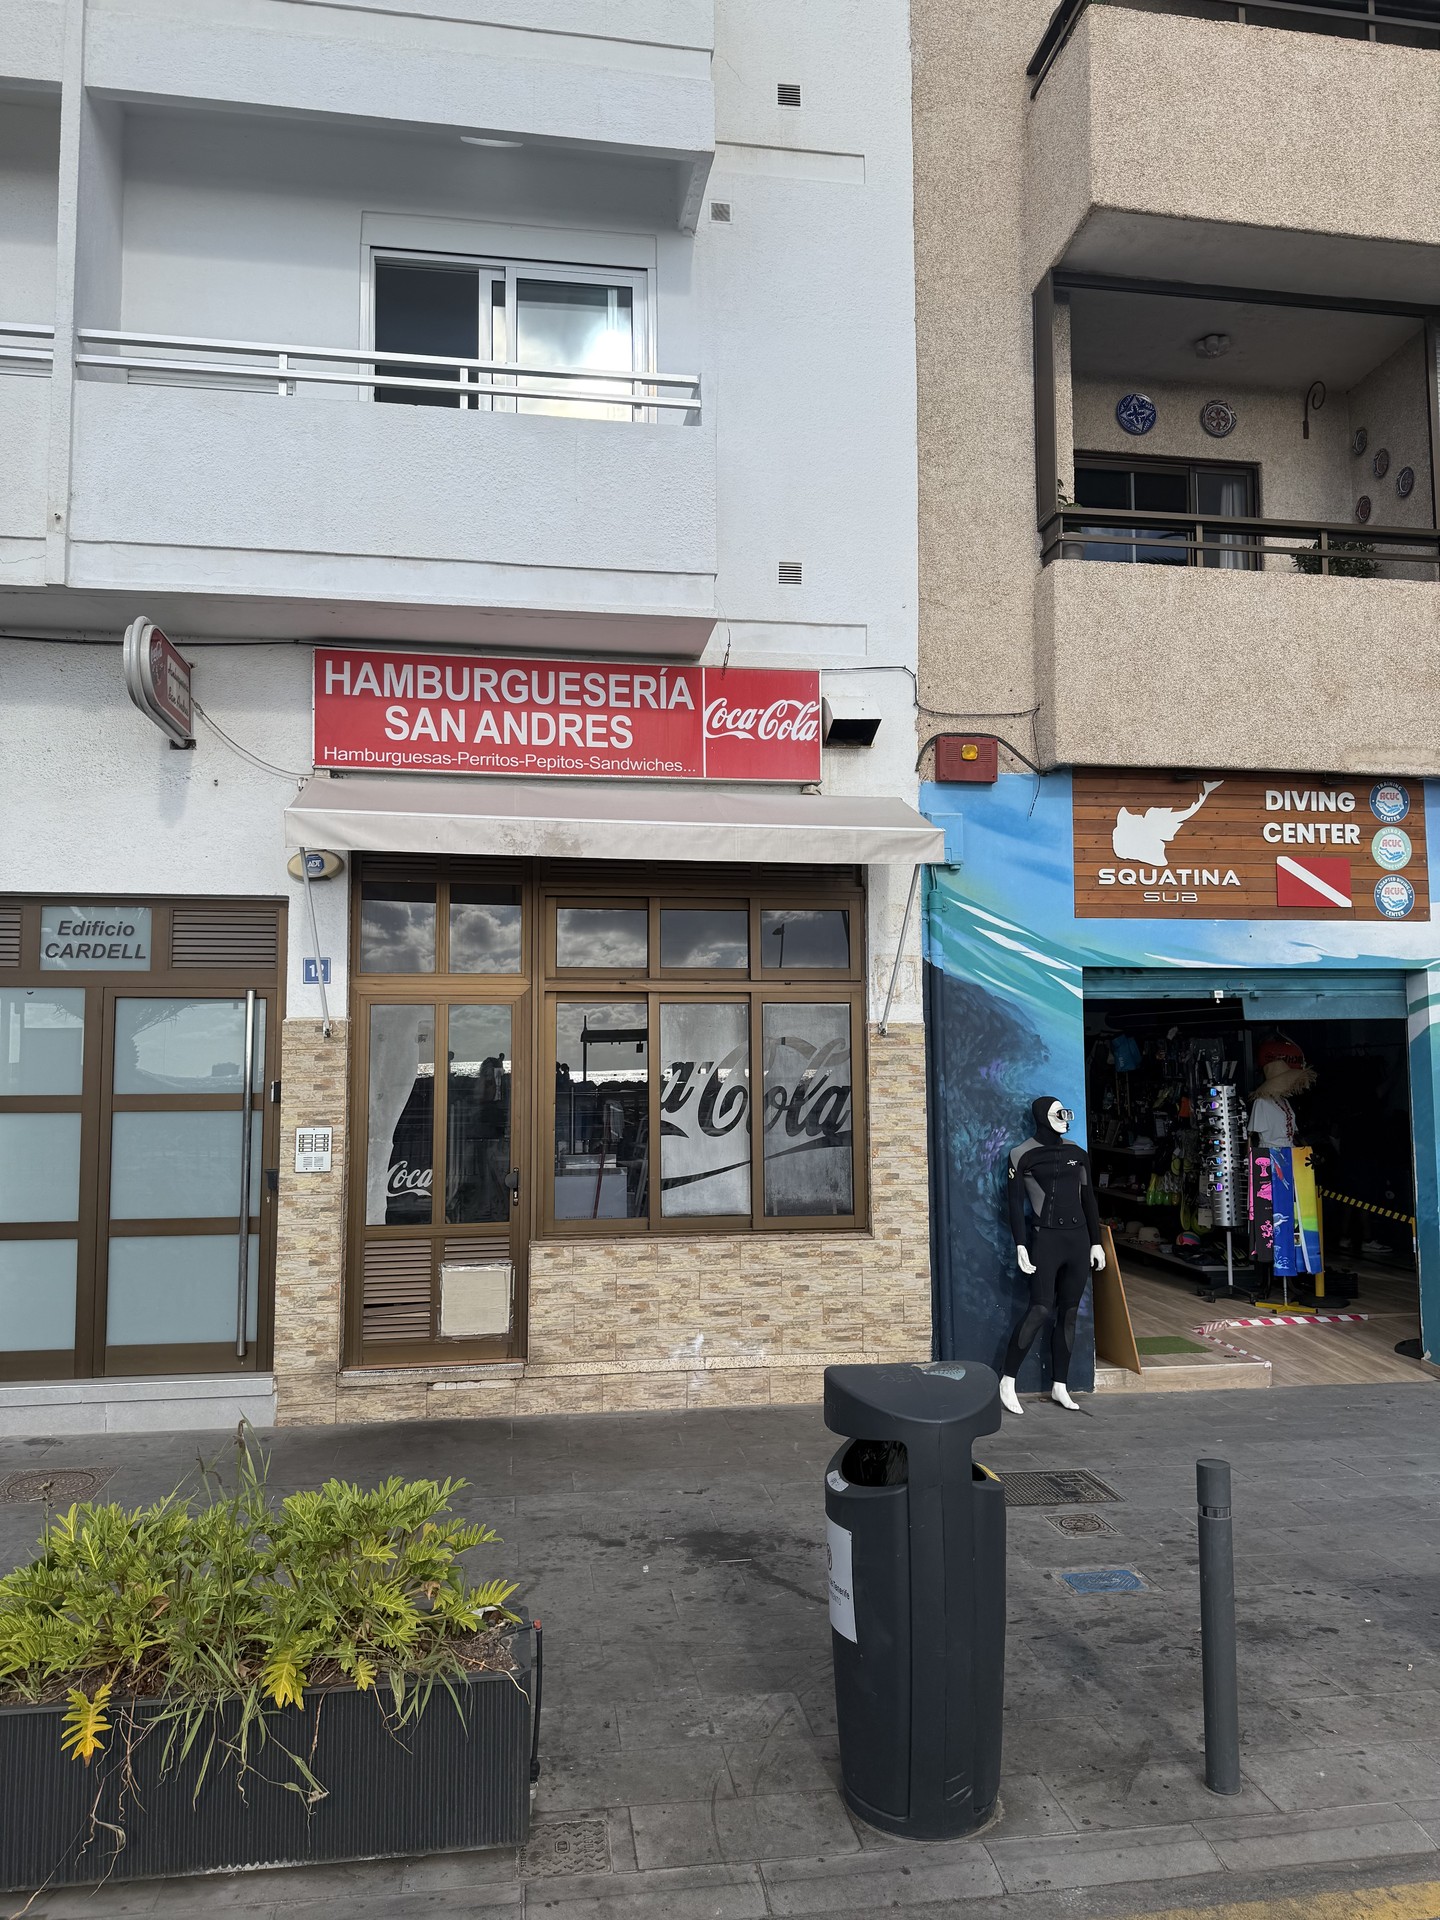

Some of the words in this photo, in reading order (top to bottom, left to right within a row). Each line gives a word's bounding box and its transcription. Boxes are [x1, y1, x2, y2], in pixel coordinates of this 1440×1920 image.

[325, 660, 695, 710] HAMBURGUESERÍA
[385, 705, 466, 743] SAN
[473, 710, 633, 749] ANDRES
[704, 697, 818, 743] Coca-Cola
[1377, 782, 1402, 791] TRAINING
[1265, 790, 1356, 812] DIVING
[1379, 792, 1400, 800] ACUC
[1380, 814, 1401, 823] CENTER
[1263, 822, 1361, 845] CENTER
[1382, 839, 1402, 848] ACUC
[307, 859, 322, 868] ADT
[1098, 868, 1242, 887] SQUATINA
[1143, 892, 1198, 903] SUB
[1384, 887, 1405, 896] ACUC
[1385, 909, 1405, 917] CENTER
[57, 920, 136, 937] Edificio
[44, 943, 147, 960] CARDELL
